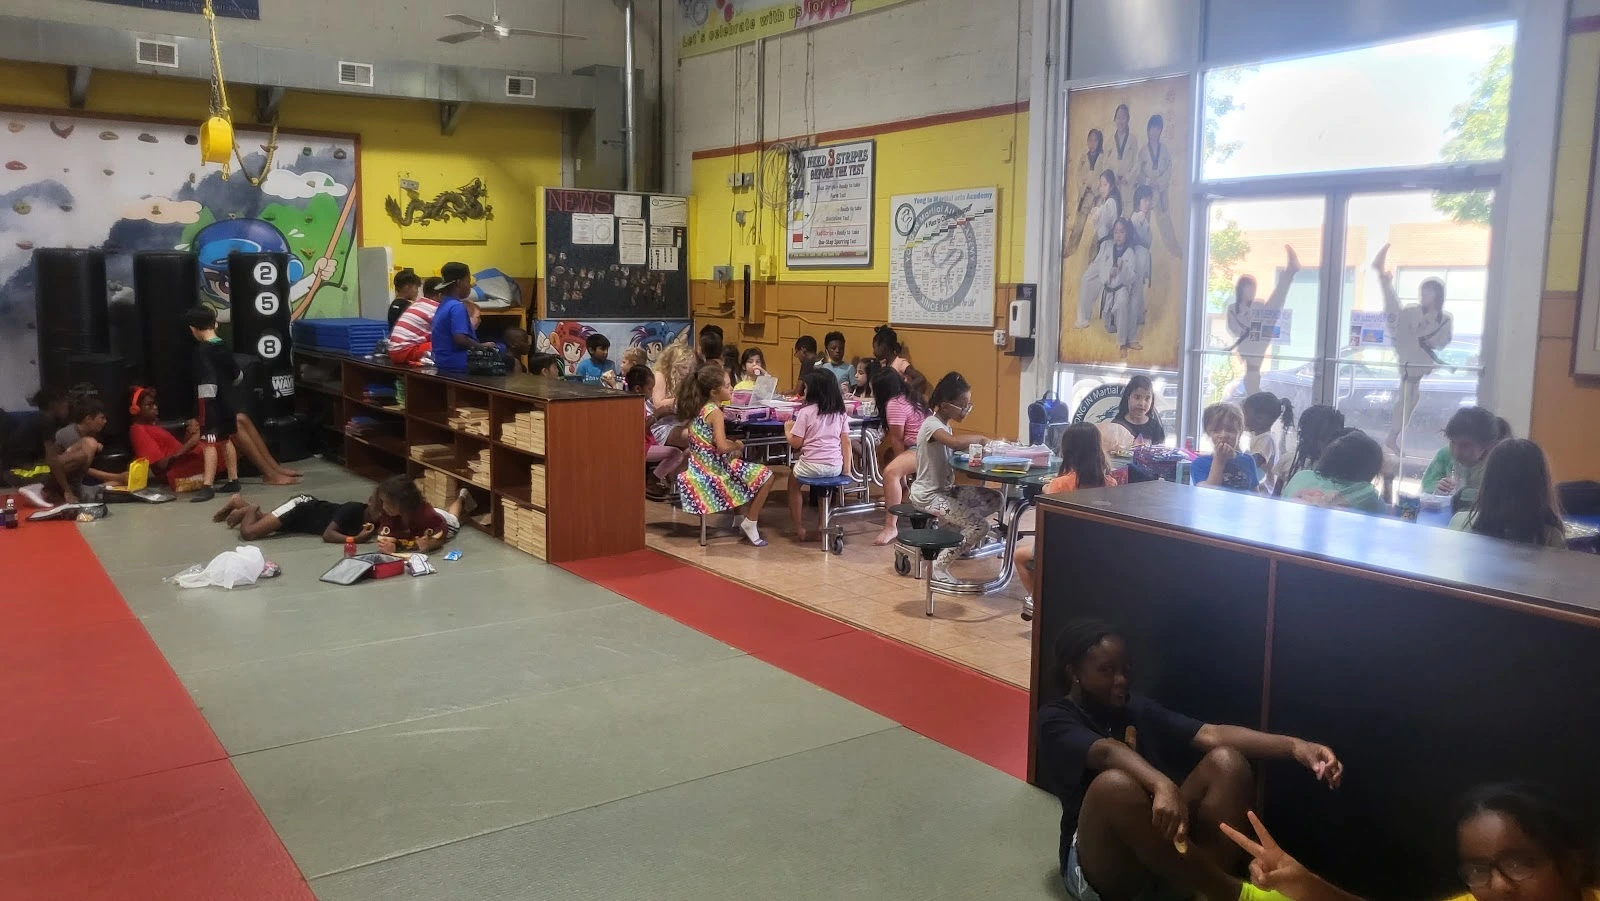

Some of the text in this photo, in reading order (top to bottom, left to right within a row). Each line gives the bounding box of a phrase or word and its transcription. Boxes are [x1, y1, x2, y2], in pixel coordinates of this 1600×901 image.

[682, 30, 705, 48] Let's
[709, 18, 756, 40] celebrate
[759, 9, 785, 26] with
[788, 6, 803, 20] us
[807, 149, 868, 168] NEED 3 STRIPES
[810, 164, 865, 180] BEFORE THE TEST
[547, 190, 612, 214] NEWS
[914, 197, 926, 205] Yong
[966, 191, 992, 200] Academy
[919, 205, 943, 224] Martial
[259, 265, 272, 281] 2
[261, 296, 274, 311] 5
[921, 295, 939, 312] SINCE
[263, 339, 276, 355] 8
[1084, 395, 1094, 406] IN
[1092, 385, 1119, 400] Martial
